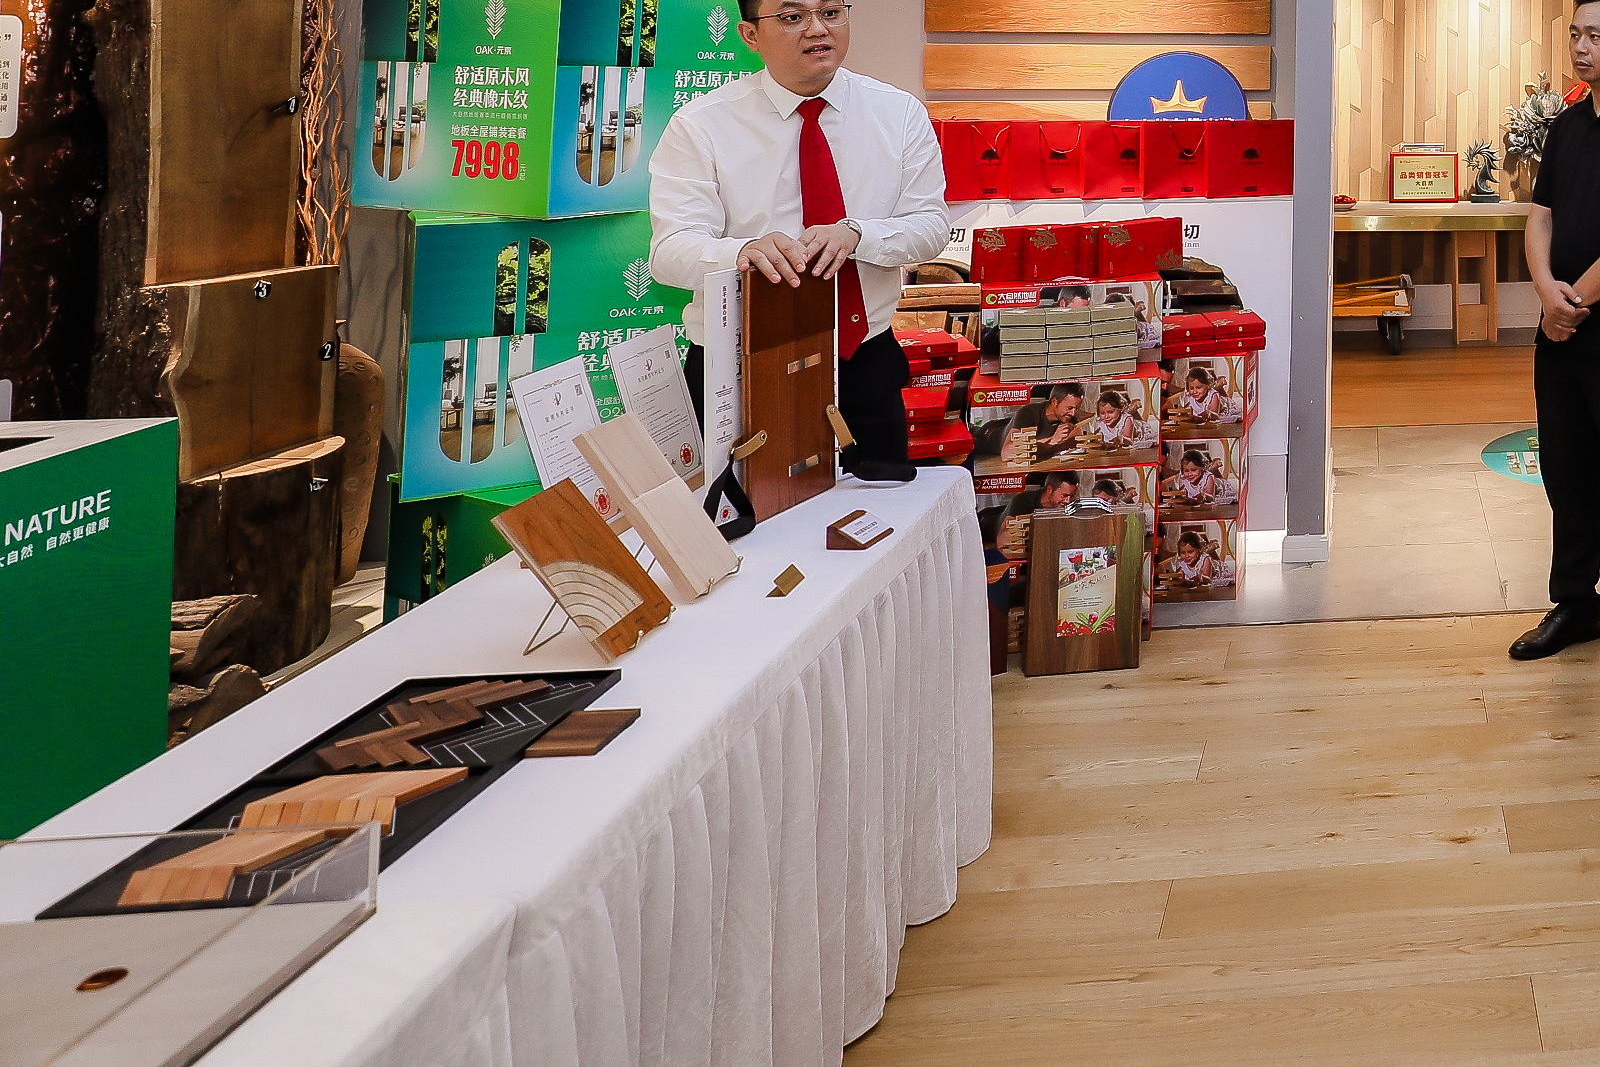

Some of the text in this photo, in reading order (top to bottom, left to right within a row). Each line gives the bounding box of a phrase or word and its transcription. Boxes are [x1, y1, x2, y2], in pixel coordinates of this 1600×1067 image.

[454, 66, 530, 87] 舒适原木风
[453, 88, 529, 110] 经典橡木纹
[451, 124, 527, 140] 地板全屋铺装套餐
[451, 140, 519, 181] 7998
[998, 291, 1037, 300] 大自然地板
[324, 343, 332, 359] 2
[912, 373, 951, 385] 大自然地板
[987, 390, 1027, 399] 大自然地板
[982, 477, 1022, 485] 大自然地板
[5, 489, 111, 546] NATURE
[46, 517, 110, 551] 自然更健康
